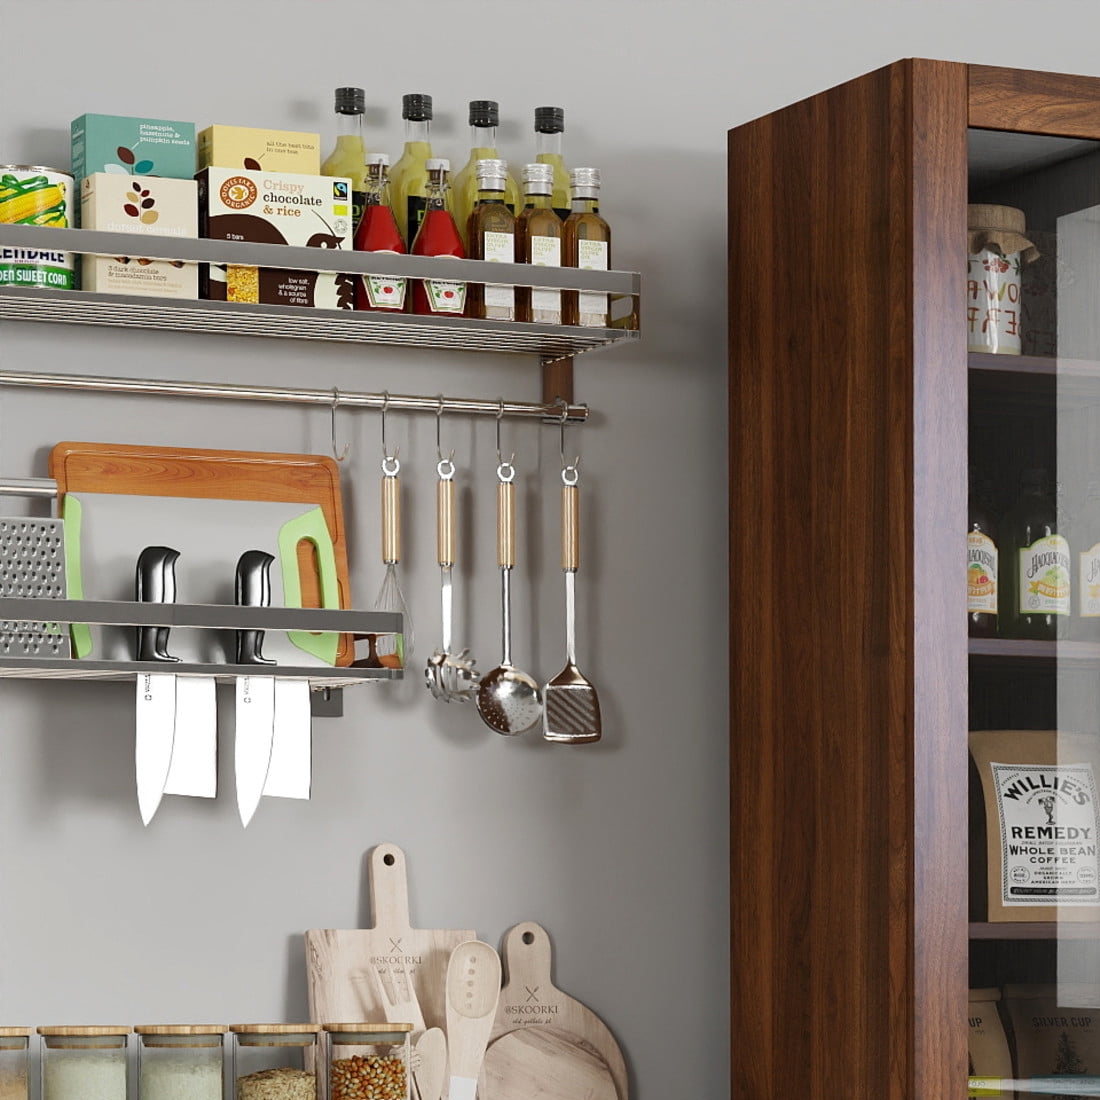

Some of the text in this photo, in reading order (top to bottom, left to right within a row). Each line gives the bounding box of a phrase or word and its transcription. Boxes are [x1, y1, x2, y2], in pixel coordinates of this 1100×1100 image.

[263, 180, 304, 194] Crispy
[263, 192, 322, 206] chocolate
[263, 204, 301, 217] & rice
[1004, 775, 1090, 806] WILLIE'S
[1011, 826, 1091, 839] REMEDY
[1009, 844, 1096, 856] WHOLE BEAN
[504, 1005, 558, 1014] @SKOORKI
[1032, 1016, 1092, 1027] SILVER CUP
